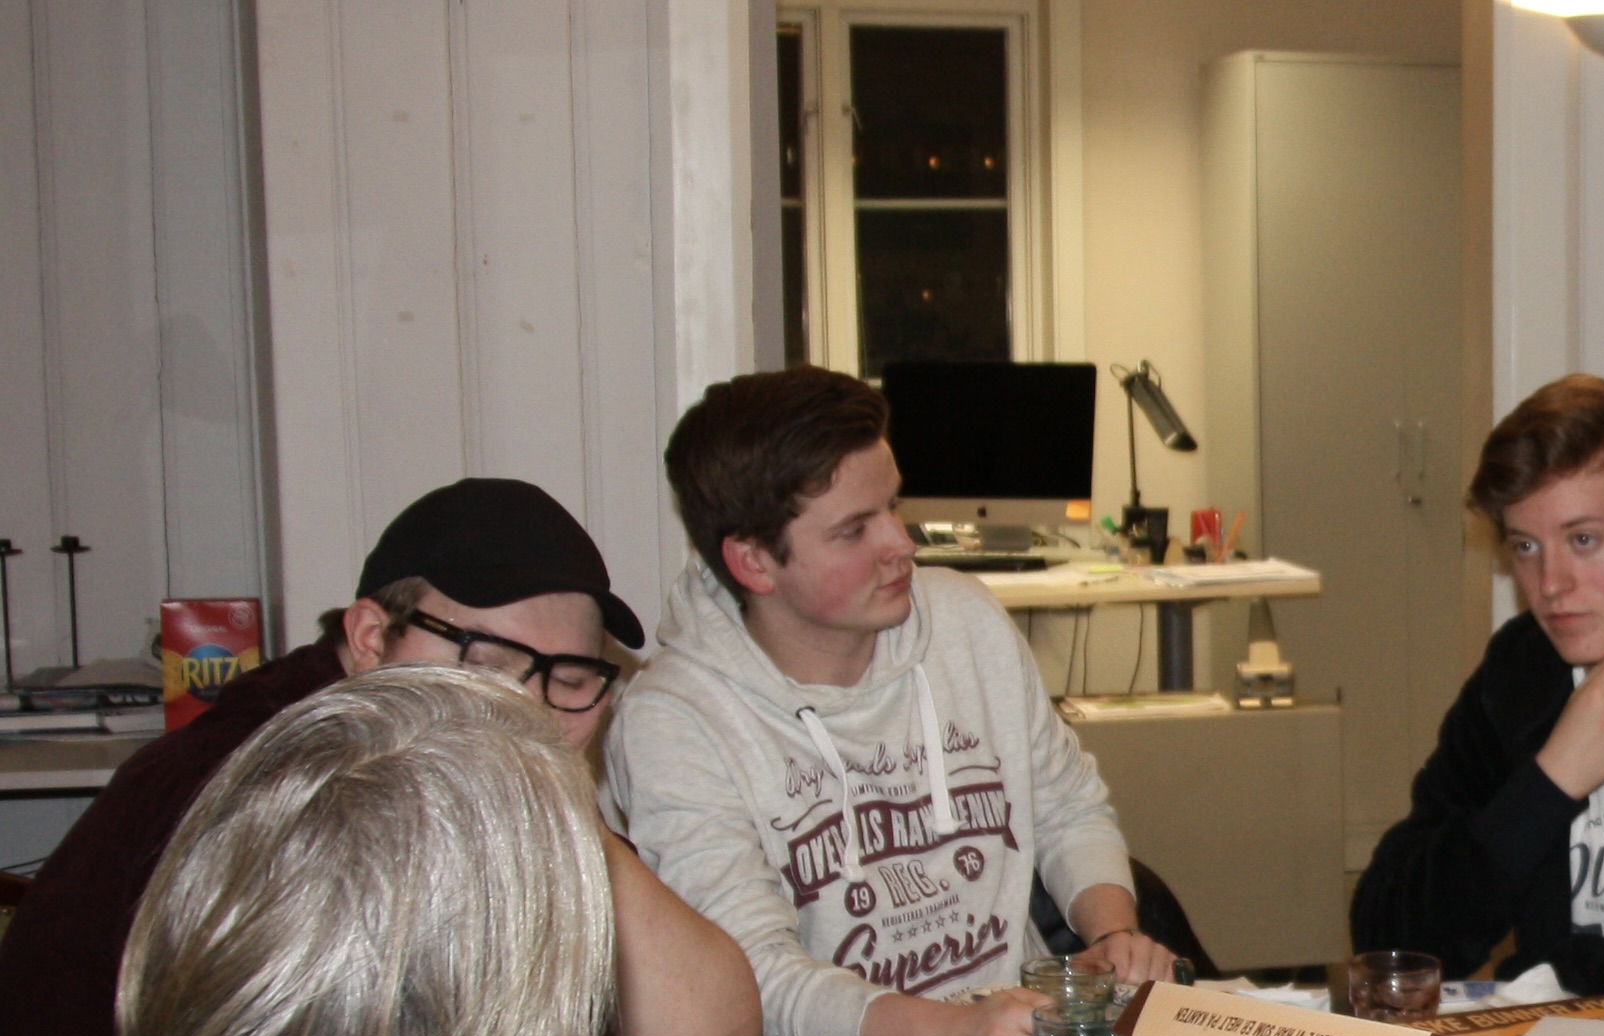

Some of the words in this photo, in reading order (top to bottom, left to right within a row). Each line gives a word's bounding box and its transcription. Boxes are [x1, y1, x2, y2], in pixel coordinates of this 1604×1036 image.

[182, 657, 238, 689] RITZ
[958, 852, 980, 875] 76
[878, 860, 950, 908] REG.
[852, 887, 870, 911] 19
[832, 913, 1009, 993] Superior
[1174, 1007, 1210, 1024] KANTEN
[1219, 1017, 1241, 1032] HELT
[1240, 1020, 1257, 1034] ER
[1466, 1004, 1571, 1030] BUNNER
